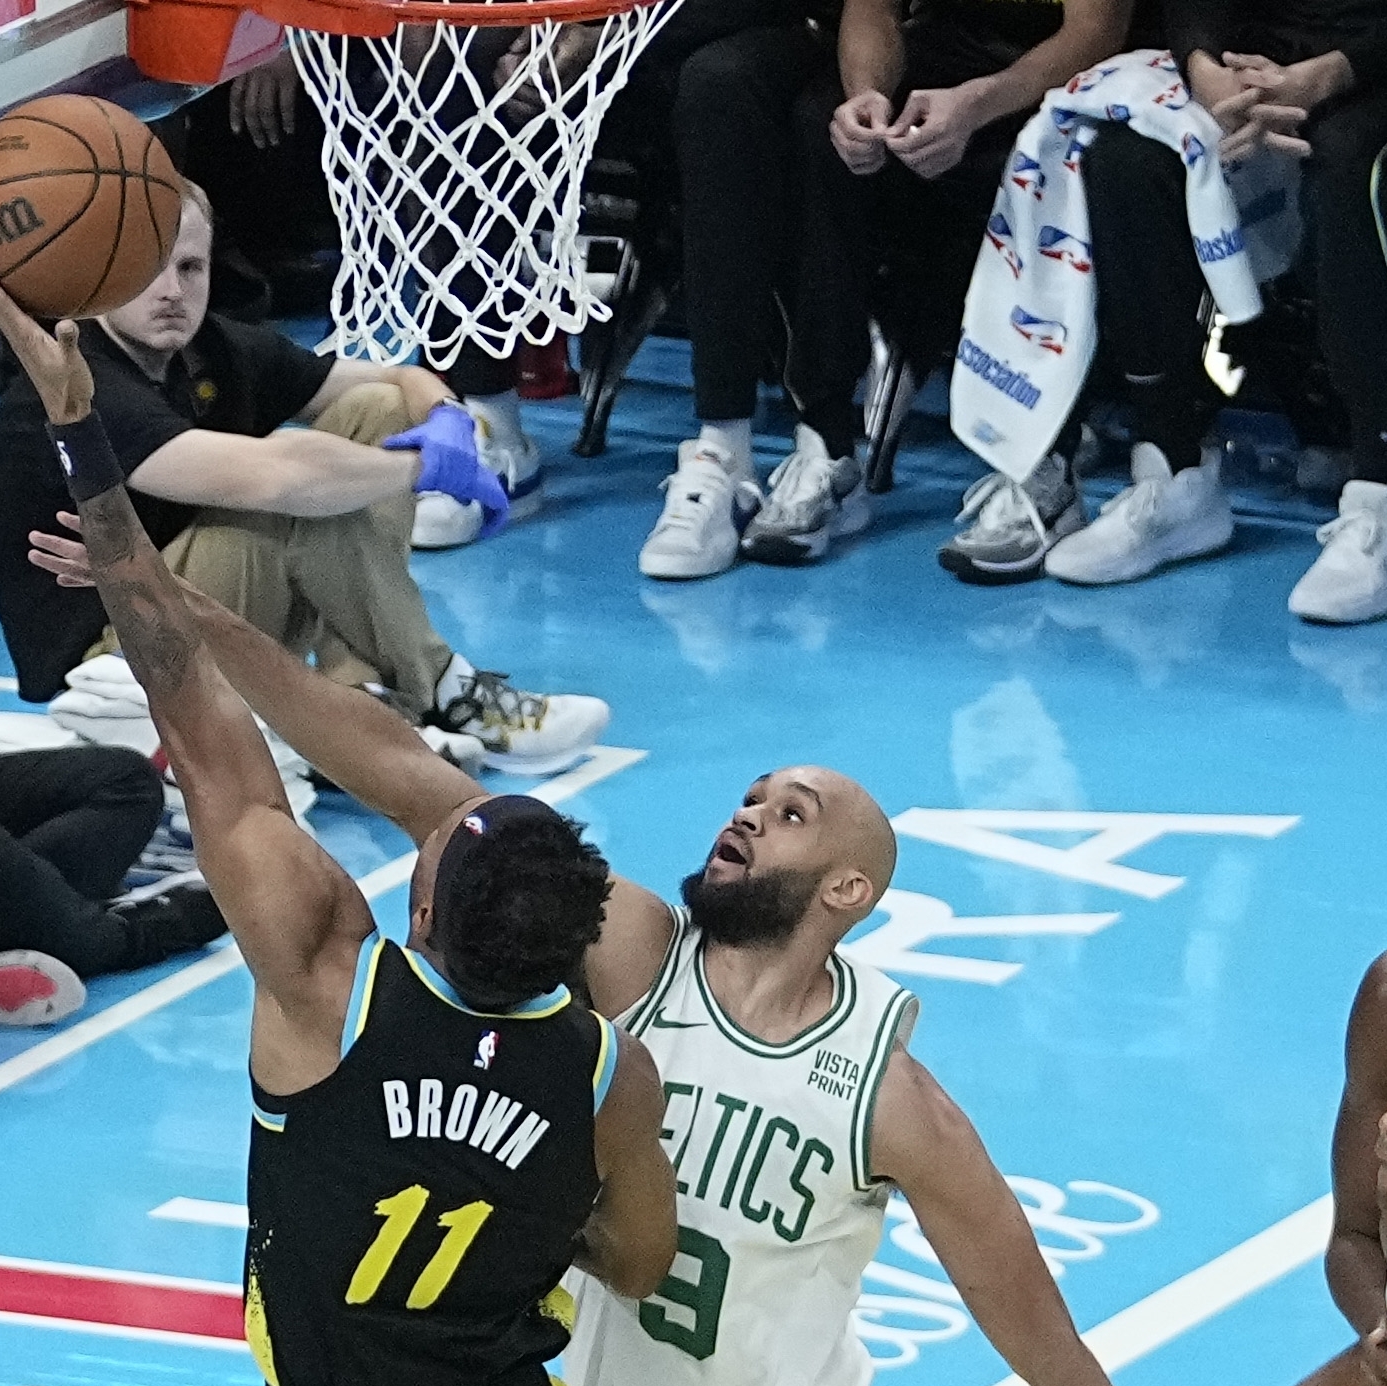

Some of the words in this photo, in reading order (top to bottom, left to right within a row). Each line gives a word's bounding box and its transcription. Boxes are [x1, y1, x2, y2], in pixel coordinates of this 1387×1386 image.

[835, 806, 1302, 986] RA
[382, 1078, 551, 1171] BROWN
[807, 1070, 856, 1101] PRINT
[814, 1048, 860, 1085] VISTA
[659, 1081, 835, 1243] ELTICS
[345, 1184, 494, 1310] 11
[638, 1224, 731, 1361] 9
